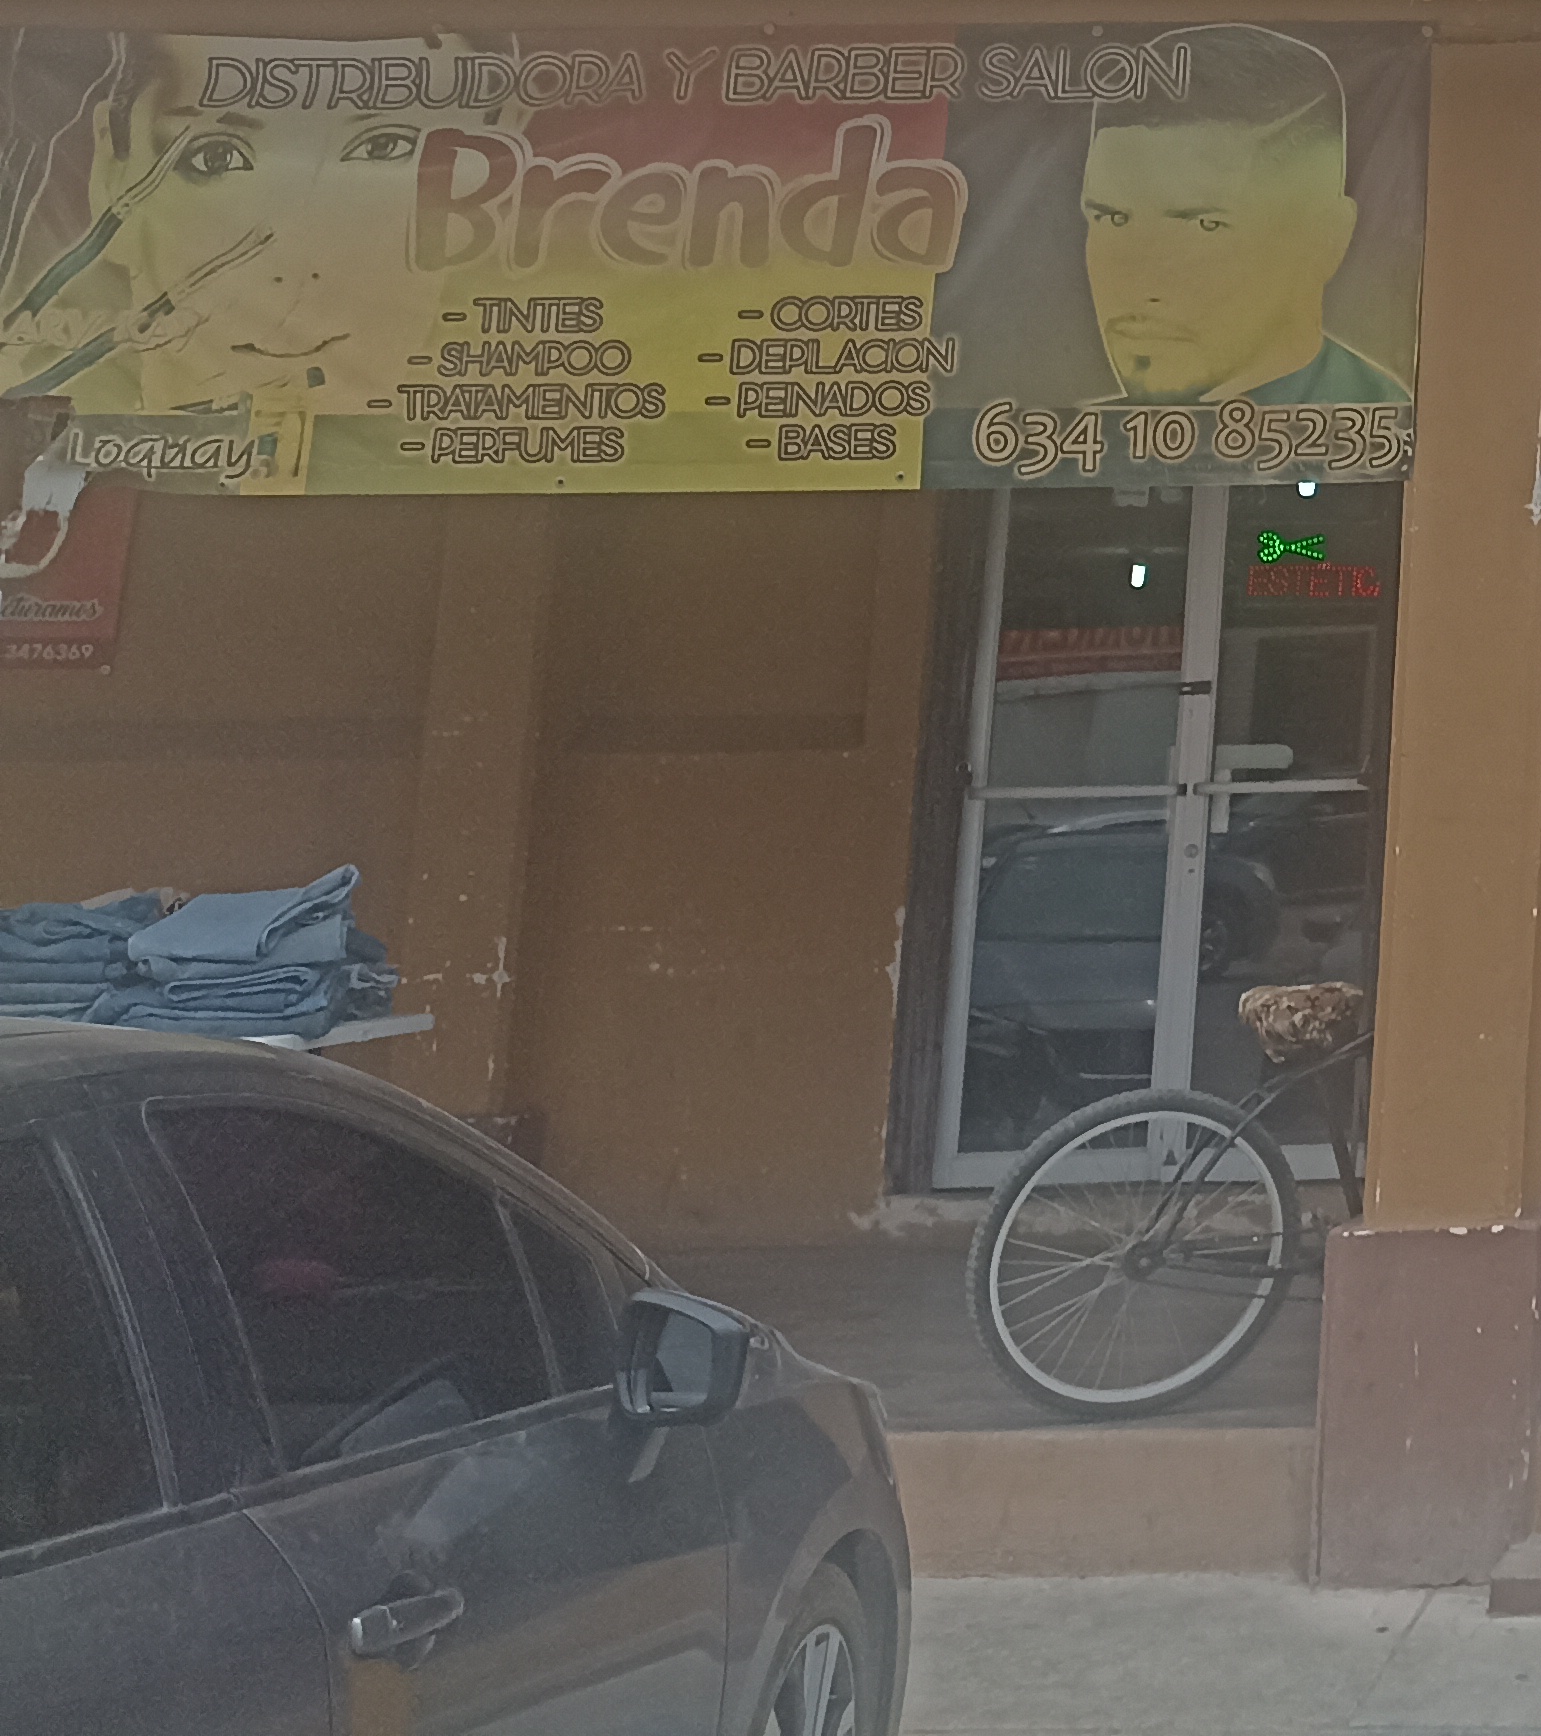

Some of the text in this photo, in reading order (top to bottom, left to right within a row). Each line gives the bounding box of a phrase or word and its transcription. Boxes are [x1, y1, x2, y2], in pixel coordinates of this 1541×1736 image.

[199, 43, 1192, 110] DISTRIBUIDORA Y BARBER SALON
[405, 114, 969, 275] Brenda
[972, 398, 1403, 478] 634 10 85235
